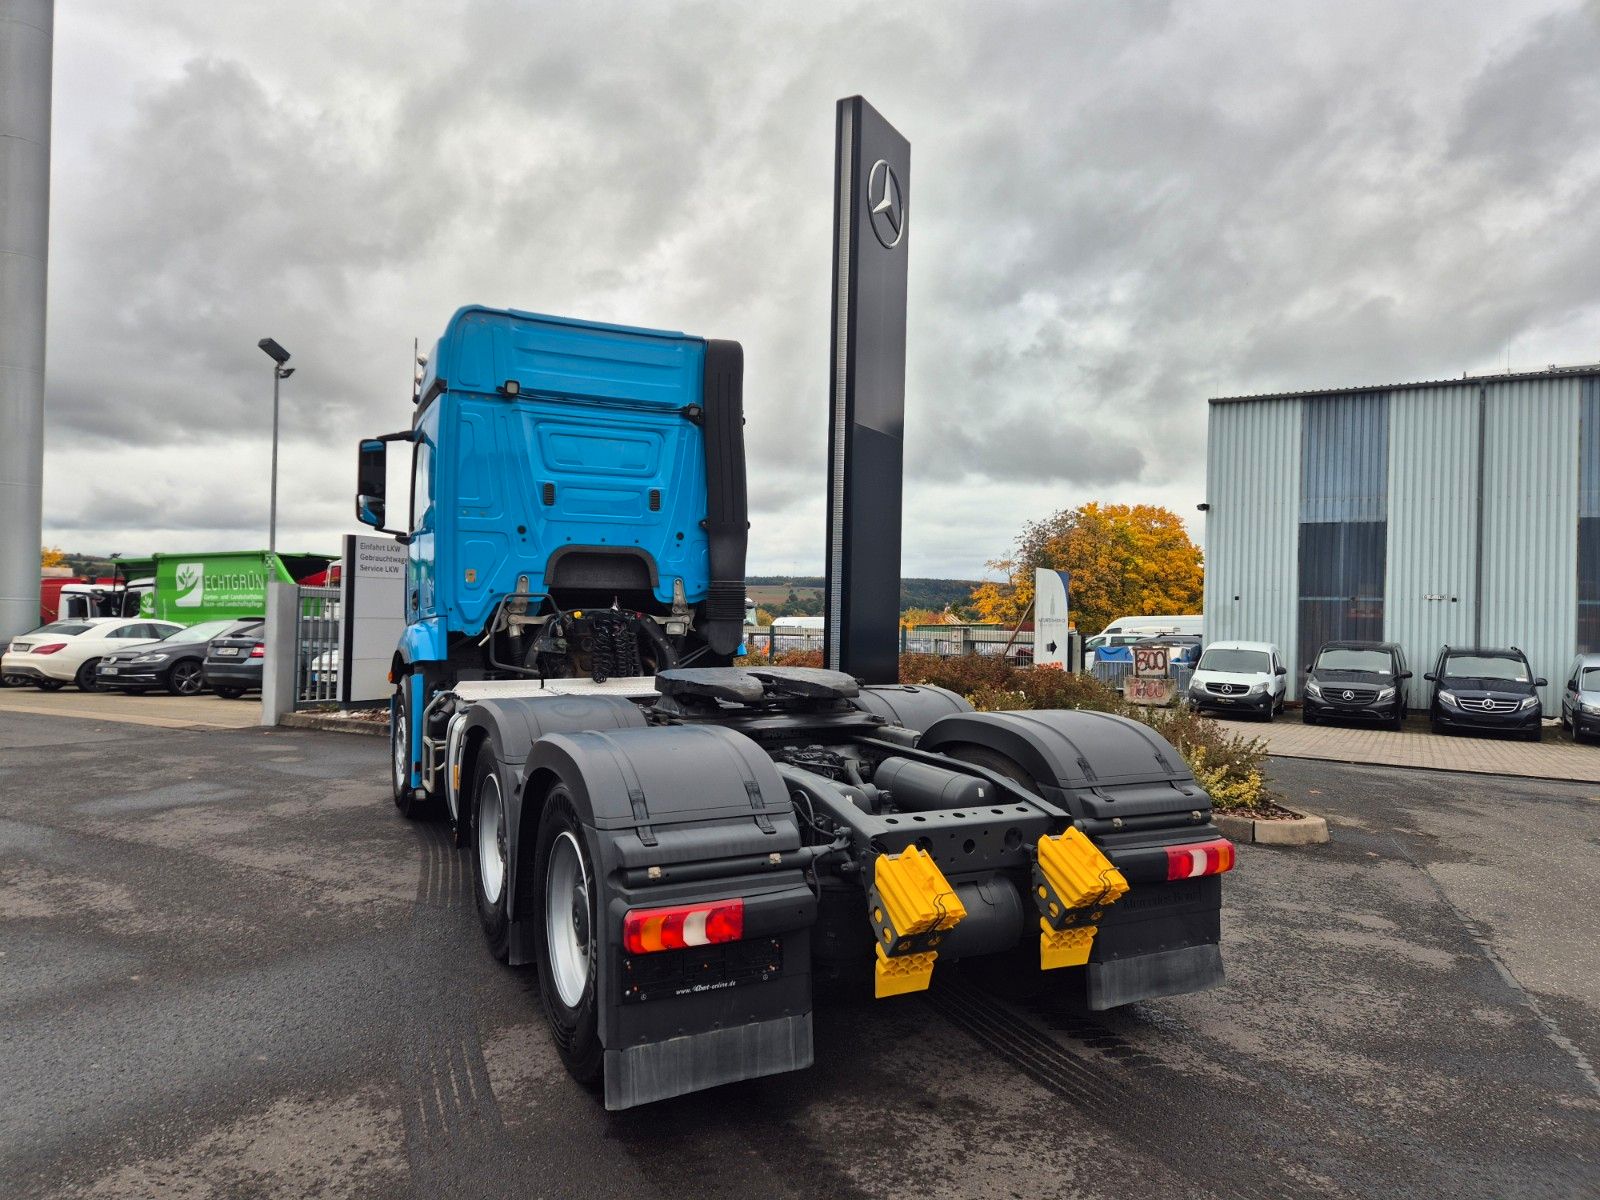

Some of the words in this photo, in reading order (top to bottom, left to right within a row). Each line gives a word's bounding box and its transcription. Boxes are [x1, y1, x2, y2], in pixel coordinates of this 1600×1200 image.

[360, 542, 385, 551] Einfahrt
[360, 564, 384, 573] Service
[204, 570, 265, 591] ECHTGRÜN
